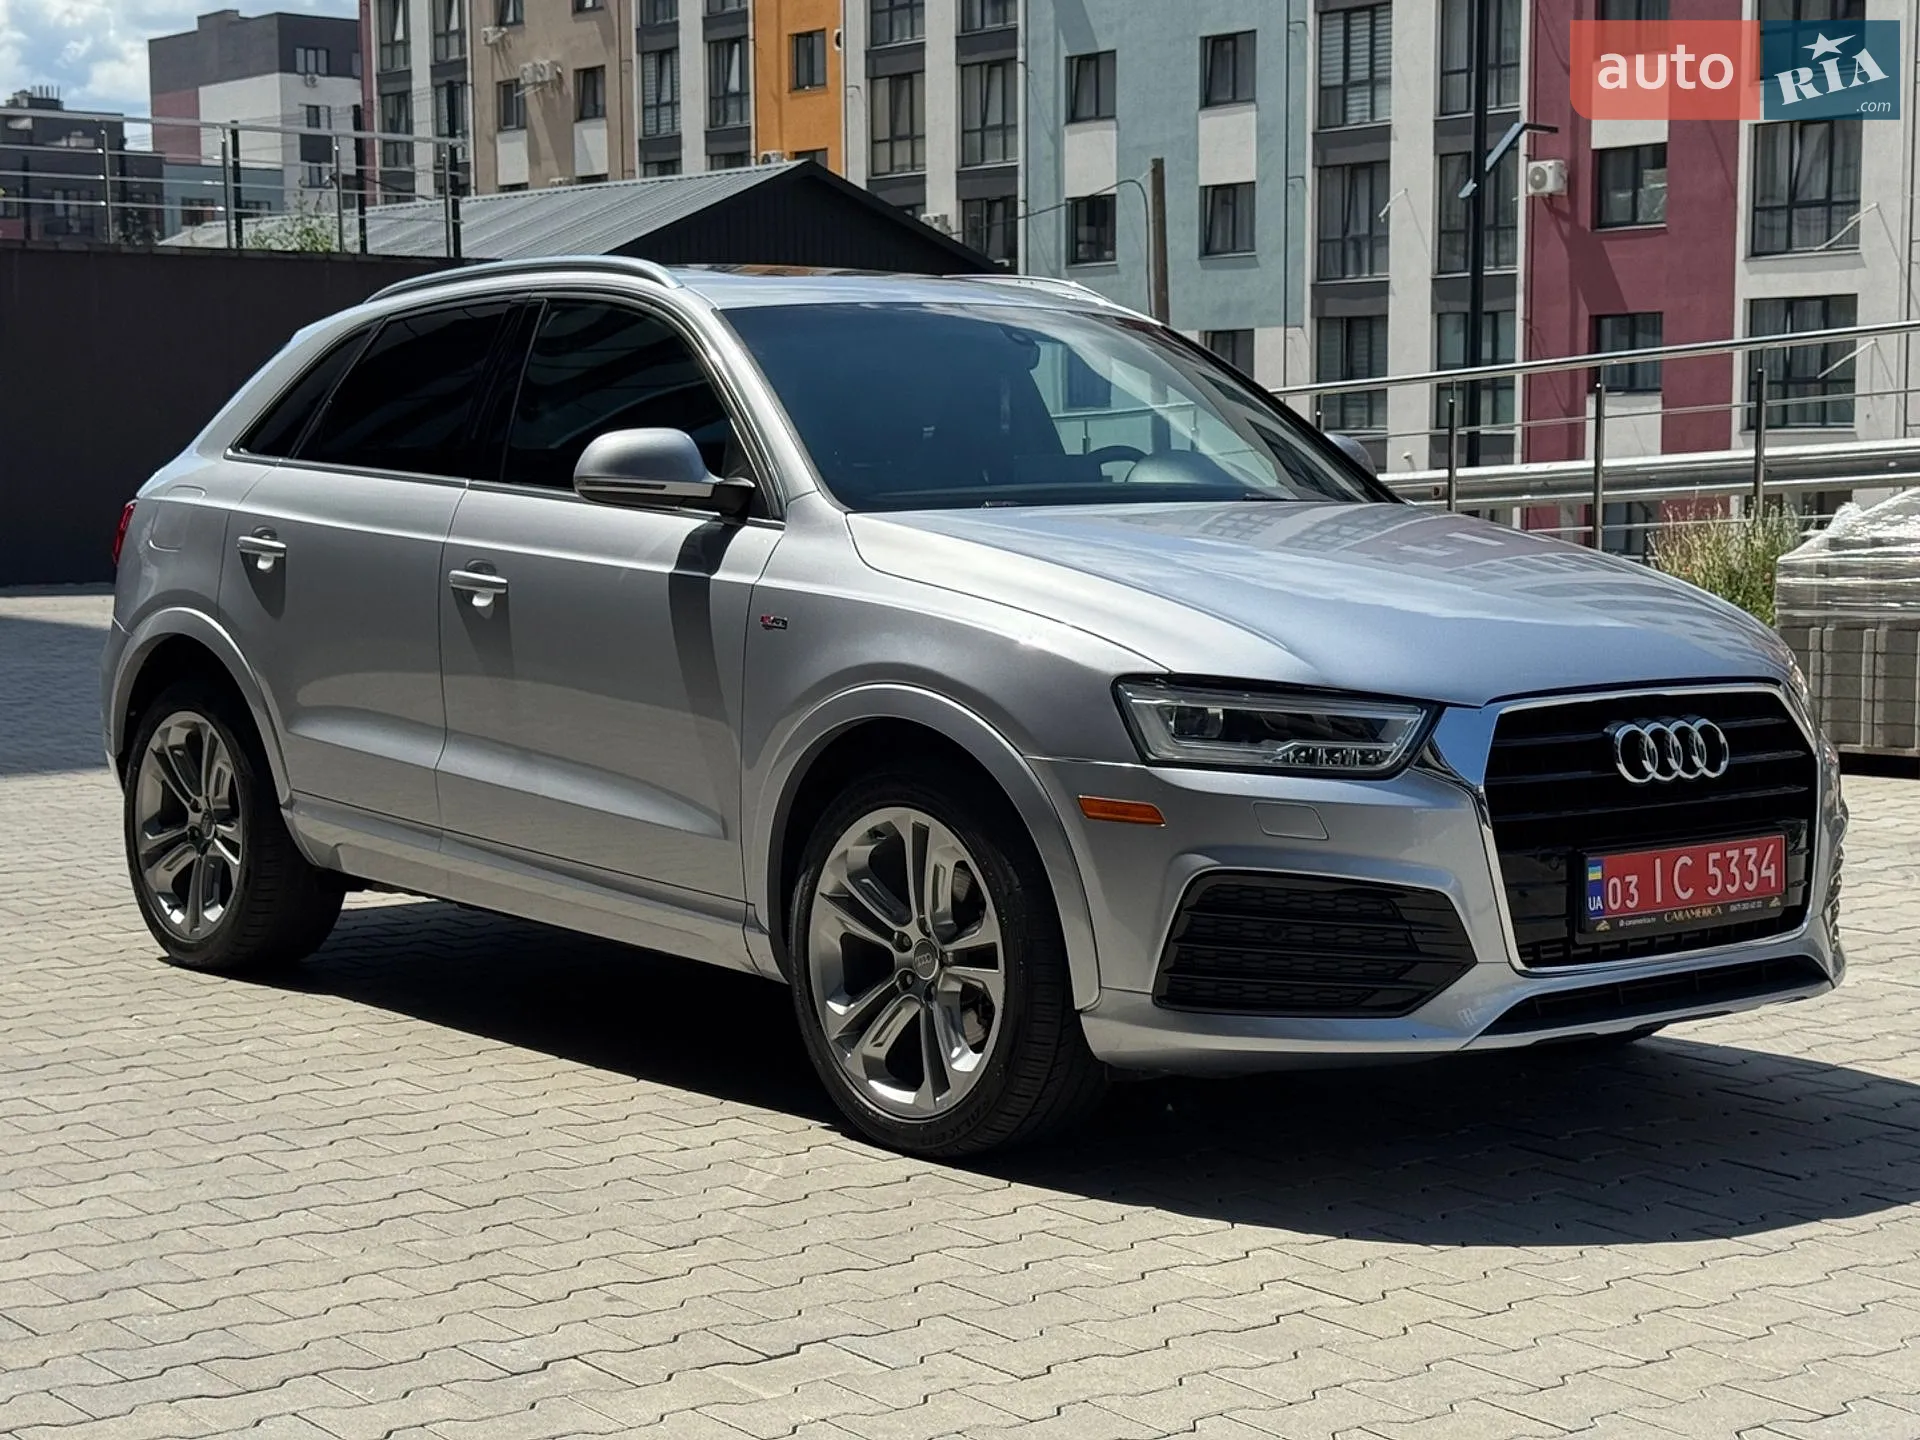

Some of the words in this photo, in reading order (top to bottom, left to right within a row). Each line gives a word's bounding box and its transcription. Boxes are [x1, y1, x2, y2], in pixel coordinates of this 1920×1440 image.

[1607, 874, 1639, 910] 03
[1654, 856, 1694, 903] IC
[1706, 844, 1776, 896] 5334
[1588, 895, 1604, 911] UA
[1664, 905, 1723, 923] CARAMERICA
